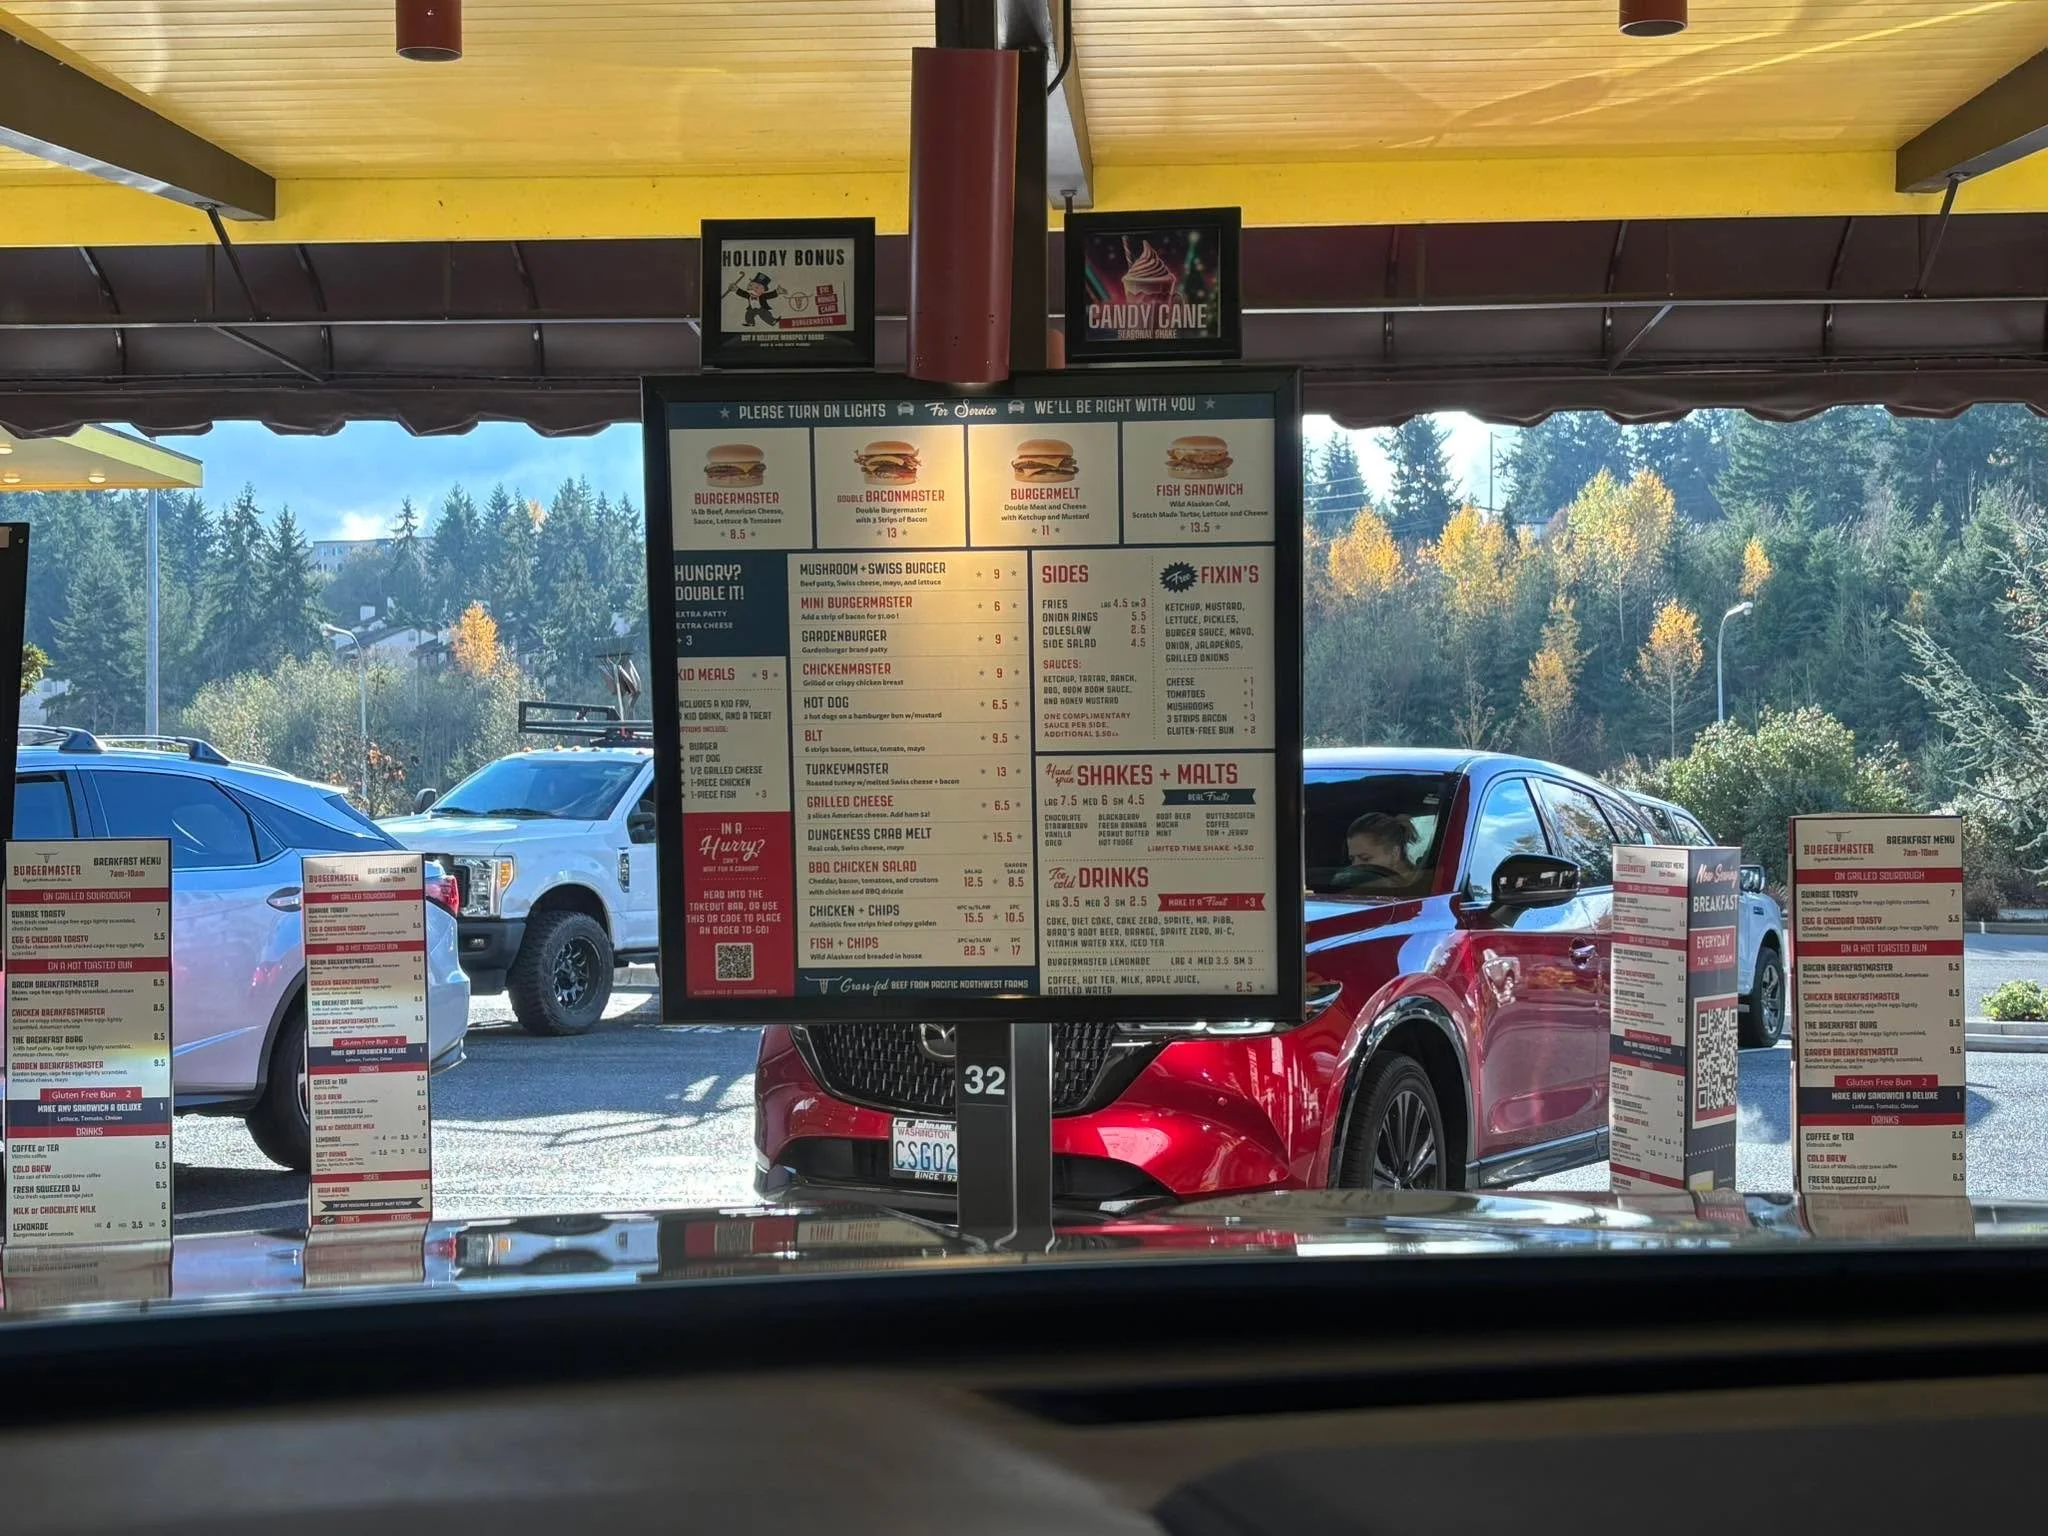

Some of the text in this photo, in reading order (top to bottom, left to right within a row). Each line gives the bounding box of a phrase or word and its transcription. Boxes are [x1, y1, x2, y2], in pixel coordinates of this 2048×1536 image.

[723, 249, 845, 267] HOLIDAY BONUS
[1088, 304, 1207, 329] CANDY CANE
[1118, 329, 1177, 339] SEASONAL SHAKE
[739, 404, 886, 419] PLEASE TURN ON LIGHTS
[925, 399, 997, 418] For Service
[1034, 397, 1196, 414] WE'LL BE RIGHT WITH YOU
[837, 490, 944, 502] DOUBLE BACONMASTER
[1011, 488, 1080, 500] BURGERMELT
[1156, 484, 1243, 496] FISH SANDWICH
[694, 492, 779, 504] BURGERMASTER
[881, 507, 927, 515] Burgermaster
[1018, 514, 1046, 522] Ketchup
[887, 528, 896, 538] 13
[1042, 526, 1050, 536] 11
[1190, 522, 1210, 533] 13.5
[730, 529, 746, 540] 8.5
[674, 564, 742, 581] HUNGRY?
[800, 563, 857, 575] MUSHROOM
[868, 563, 902, 574] SWISS
[906, 562, 946, 574] BURGER
[994, 569, 1000, 579] 9
[1042, 565, 1089, 583] SIDES
[1201, 565, 1259, 583] FIXIN'S
[675, 586, 744, 601] DOUBLE IT!
[801, 596, 1000, 611] MINI BURGERMASTER 6
[1042, 599, 1128, 608] FRIES 4.5
[1042, 612, 1146, 622] ONION RINGS 5.5
[1042, 625, 1146, 635] COLESLAW 2.5
[686, 636, 692, 645] 3
[802, 630, 1001, 644] GARDENBURGER 9
[1042, 638, 1146, 648] SIDE SALAD 4.5
[803, 663, 1002, 678] CHICKENMASTER 9
[1043, 660, 1082, 669] SAUCES:
[699, 668, 735, 680] MEALS
[762, 670, 768, 680] 9
[804, 697, 1008, 710] HOT DOG 6.5
[805, 731, 1008, 743] BLT 9.5
[806, 763, 1006, 777] TURKEYMASTER 13
[1077, 764, 1238, 786] SHAKES + MALTS
[807, 796, 1010, 811] GRILLED CHEESE 6.5
[1060, 795, 1145, 806] 7.5 MED 6 SM 4.5
[722, 822, 742, 834] IN A
[808, 828, 1012, 842] DUNGENESS CRAB MELT 15.5
[1887, 835, 1954, 844] BREAKFAST MENU
[700, 835, 765, 861] Hurry?
[1804, 844, 1874, 855] BURGERMASTER
[94, 857, 161, 865] BREAKFAST MENU
[809, 861, 917, 873] BBQ CHICKEN SALAD
[14, 865, 81, 876] BURGERMASTER
[1696, 864, 1738, 888] Now Serving
[964, 877, 1024, 887] 12.5 8.5
[1079, 867, 1149, 888] DRINKS
[1063, 897, 1080, 907] 3.5
[1085, 899, 1100, 907] MED
[1104, 897, 1110, 906] 3
[1130, 896, 1147, 906] 2.5
[1693, 894, 1738, 912] BREAKFAST
[809, 905, 854, 917] CHICKEN
[868, 905, 900, 916] CHIPS
[965, 913, 983, 923] 15.5
[1005, 913, 1024, 922] 10.5
[810, 938, 833, 949] FISH
[847, 937, 878, 949] CHIPS
[964, 945, 985, 956] 22.5
[1011, 945, 1021, 955] 17
[1697, 934, 1730, 949] EVERYDAY
[840, 977, 889, 996] Grass-fed
[960, 980, 1002, 988] NORTHWEST
[1005, 980, 1028, 988] FARMS
[964, 1065, 1005, 1095] 32
[1846, 1078, 1912, 1086] Gluten Free Bun
[52, 1091, 79, 1099] Gluten
[81, 1090, 98, 1099] Free
[101, 1090, 116, 1098] Bun
[76, 1127, 103, 1135] DRINKS
[898, 1128, 950, 1138] WASHINGTON
[895, 1141, 956, 1172] CSG02
[915, 1172, 939, 1180] SINCE
